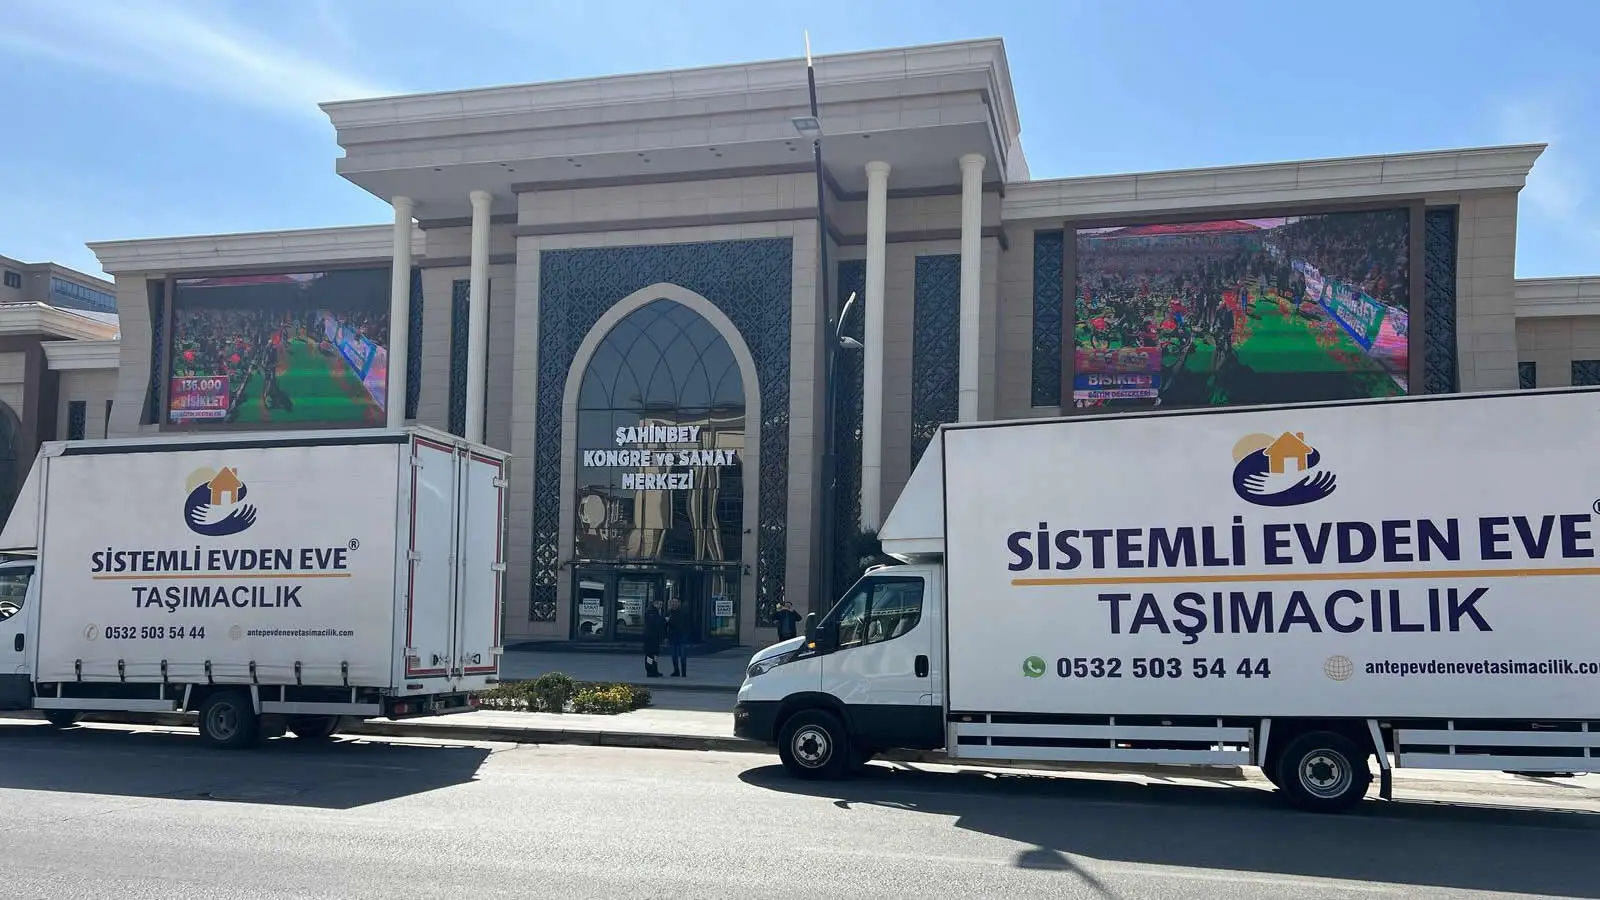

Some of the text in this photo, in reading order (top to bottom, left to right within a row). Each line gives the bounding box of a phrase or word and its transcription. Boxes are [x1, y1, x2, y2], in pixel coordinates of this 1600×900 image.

[615, 424, 700, 446] ŞAHİNBEY
[583, 449, 736, 467] KONGRE ve SANAT
[621, 469, 694, 489] MERKEZİ
[1007, 513, 1595, 572] SİSTEMLİ EVDEN EVE
[91, 545, 201, 572] SİSTEMLİ
[208, 548, 292, 571] EVDEN
[299, 547, 348, 570] EVE
[132, 585, 303, 613] TAŞIMACILIK
[1098, 587, 1494, 644] TAŞIMACILIK
[105, 626, 206, 640] 0532 503 54 44
[247, 628, 354, 638] antepevdenevetasimacilik.com
[1057, 657, 1272, 679] 0532 503 54 44
[1366, 659, 1600, 678] antepevdenevetasimacilik.co
